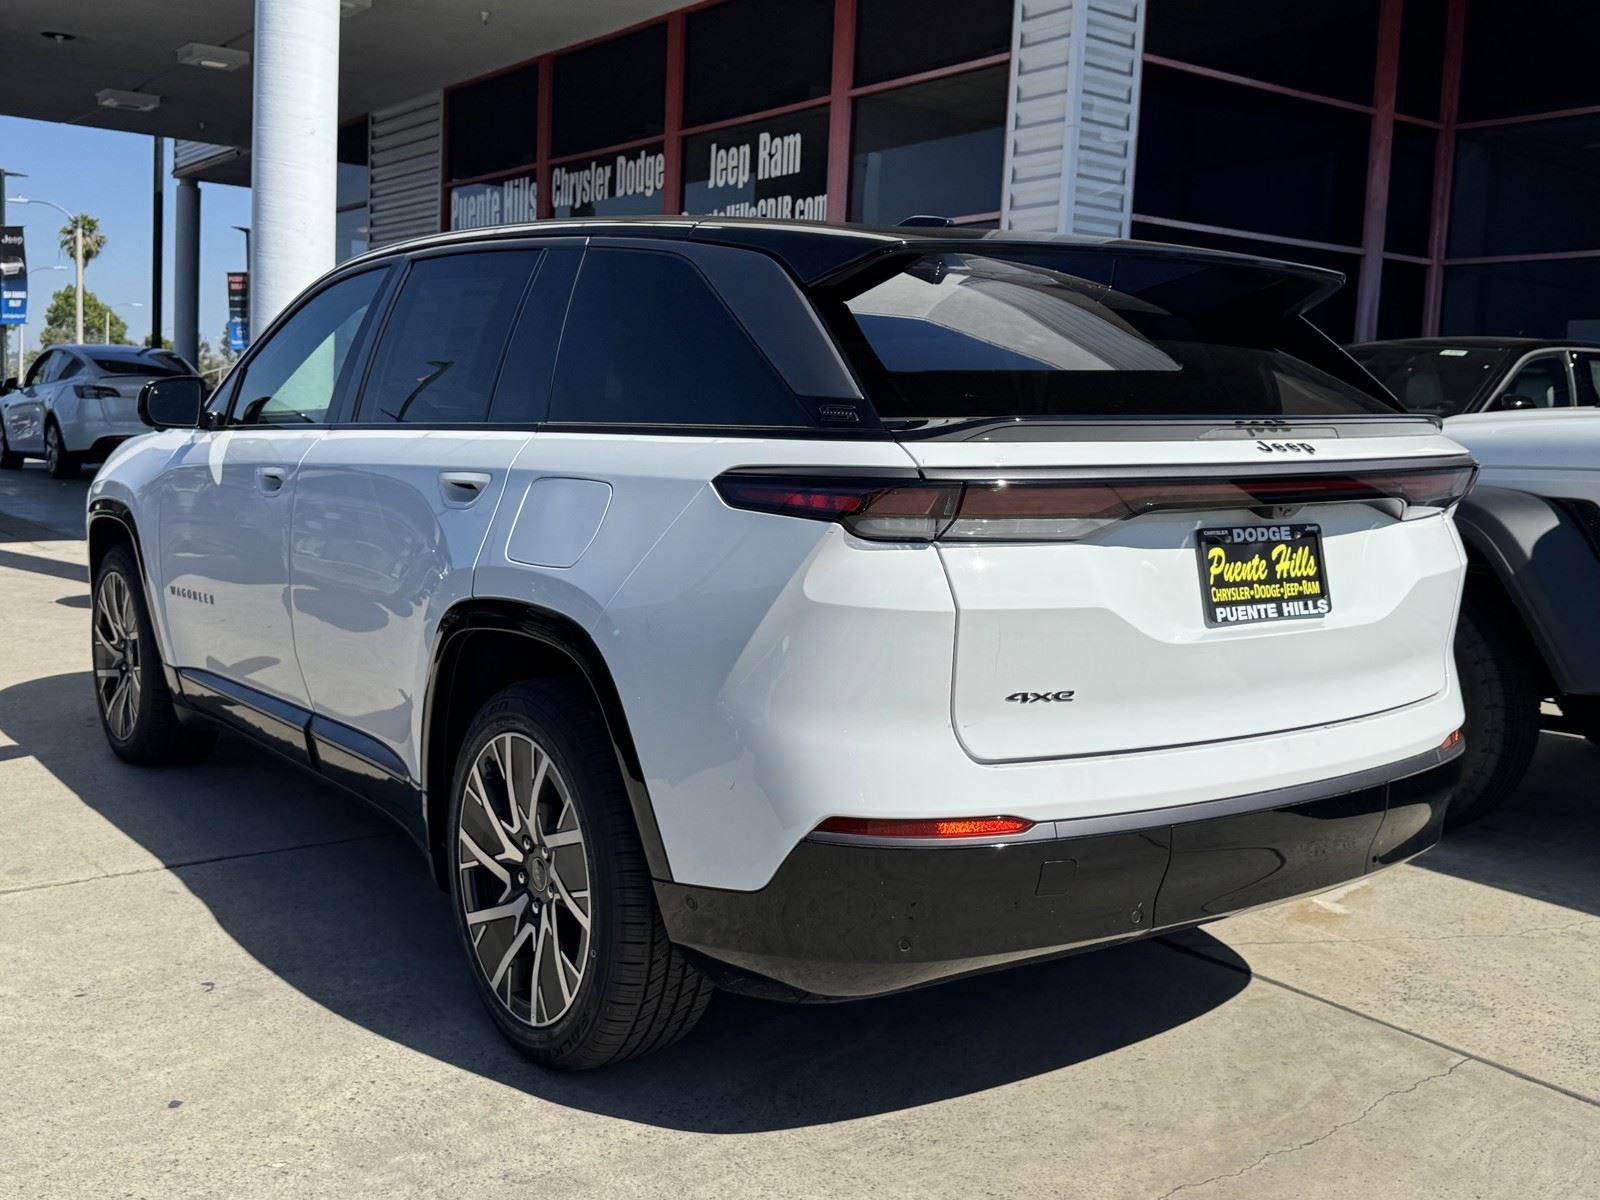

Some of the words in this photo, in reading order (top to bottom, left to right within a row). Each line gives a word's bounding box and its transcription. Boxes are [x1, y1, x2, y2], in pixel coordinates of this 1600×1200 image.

[708, 143, 750, 189] Jeep
[757, 132, 802, 180] Ram
[551, 161, 612, 209] Chrysler
[615, 150, 665, 197] Dodge
[451, 189, 500, 231] Puente
[503, 177, 537, 223] Hills
[1, 234, 24, 245] Jeep
[1256, 441, 1316, 455] Jeep
[1232, 526, 1292, 543] DODGE
[1208, 546, 1268, 585] Puente
[1271, 543, 1317, 579] Hills
[1215, 602, 1279, 623] PUENTE
[1282, 599, 1329, 617] HILLS
